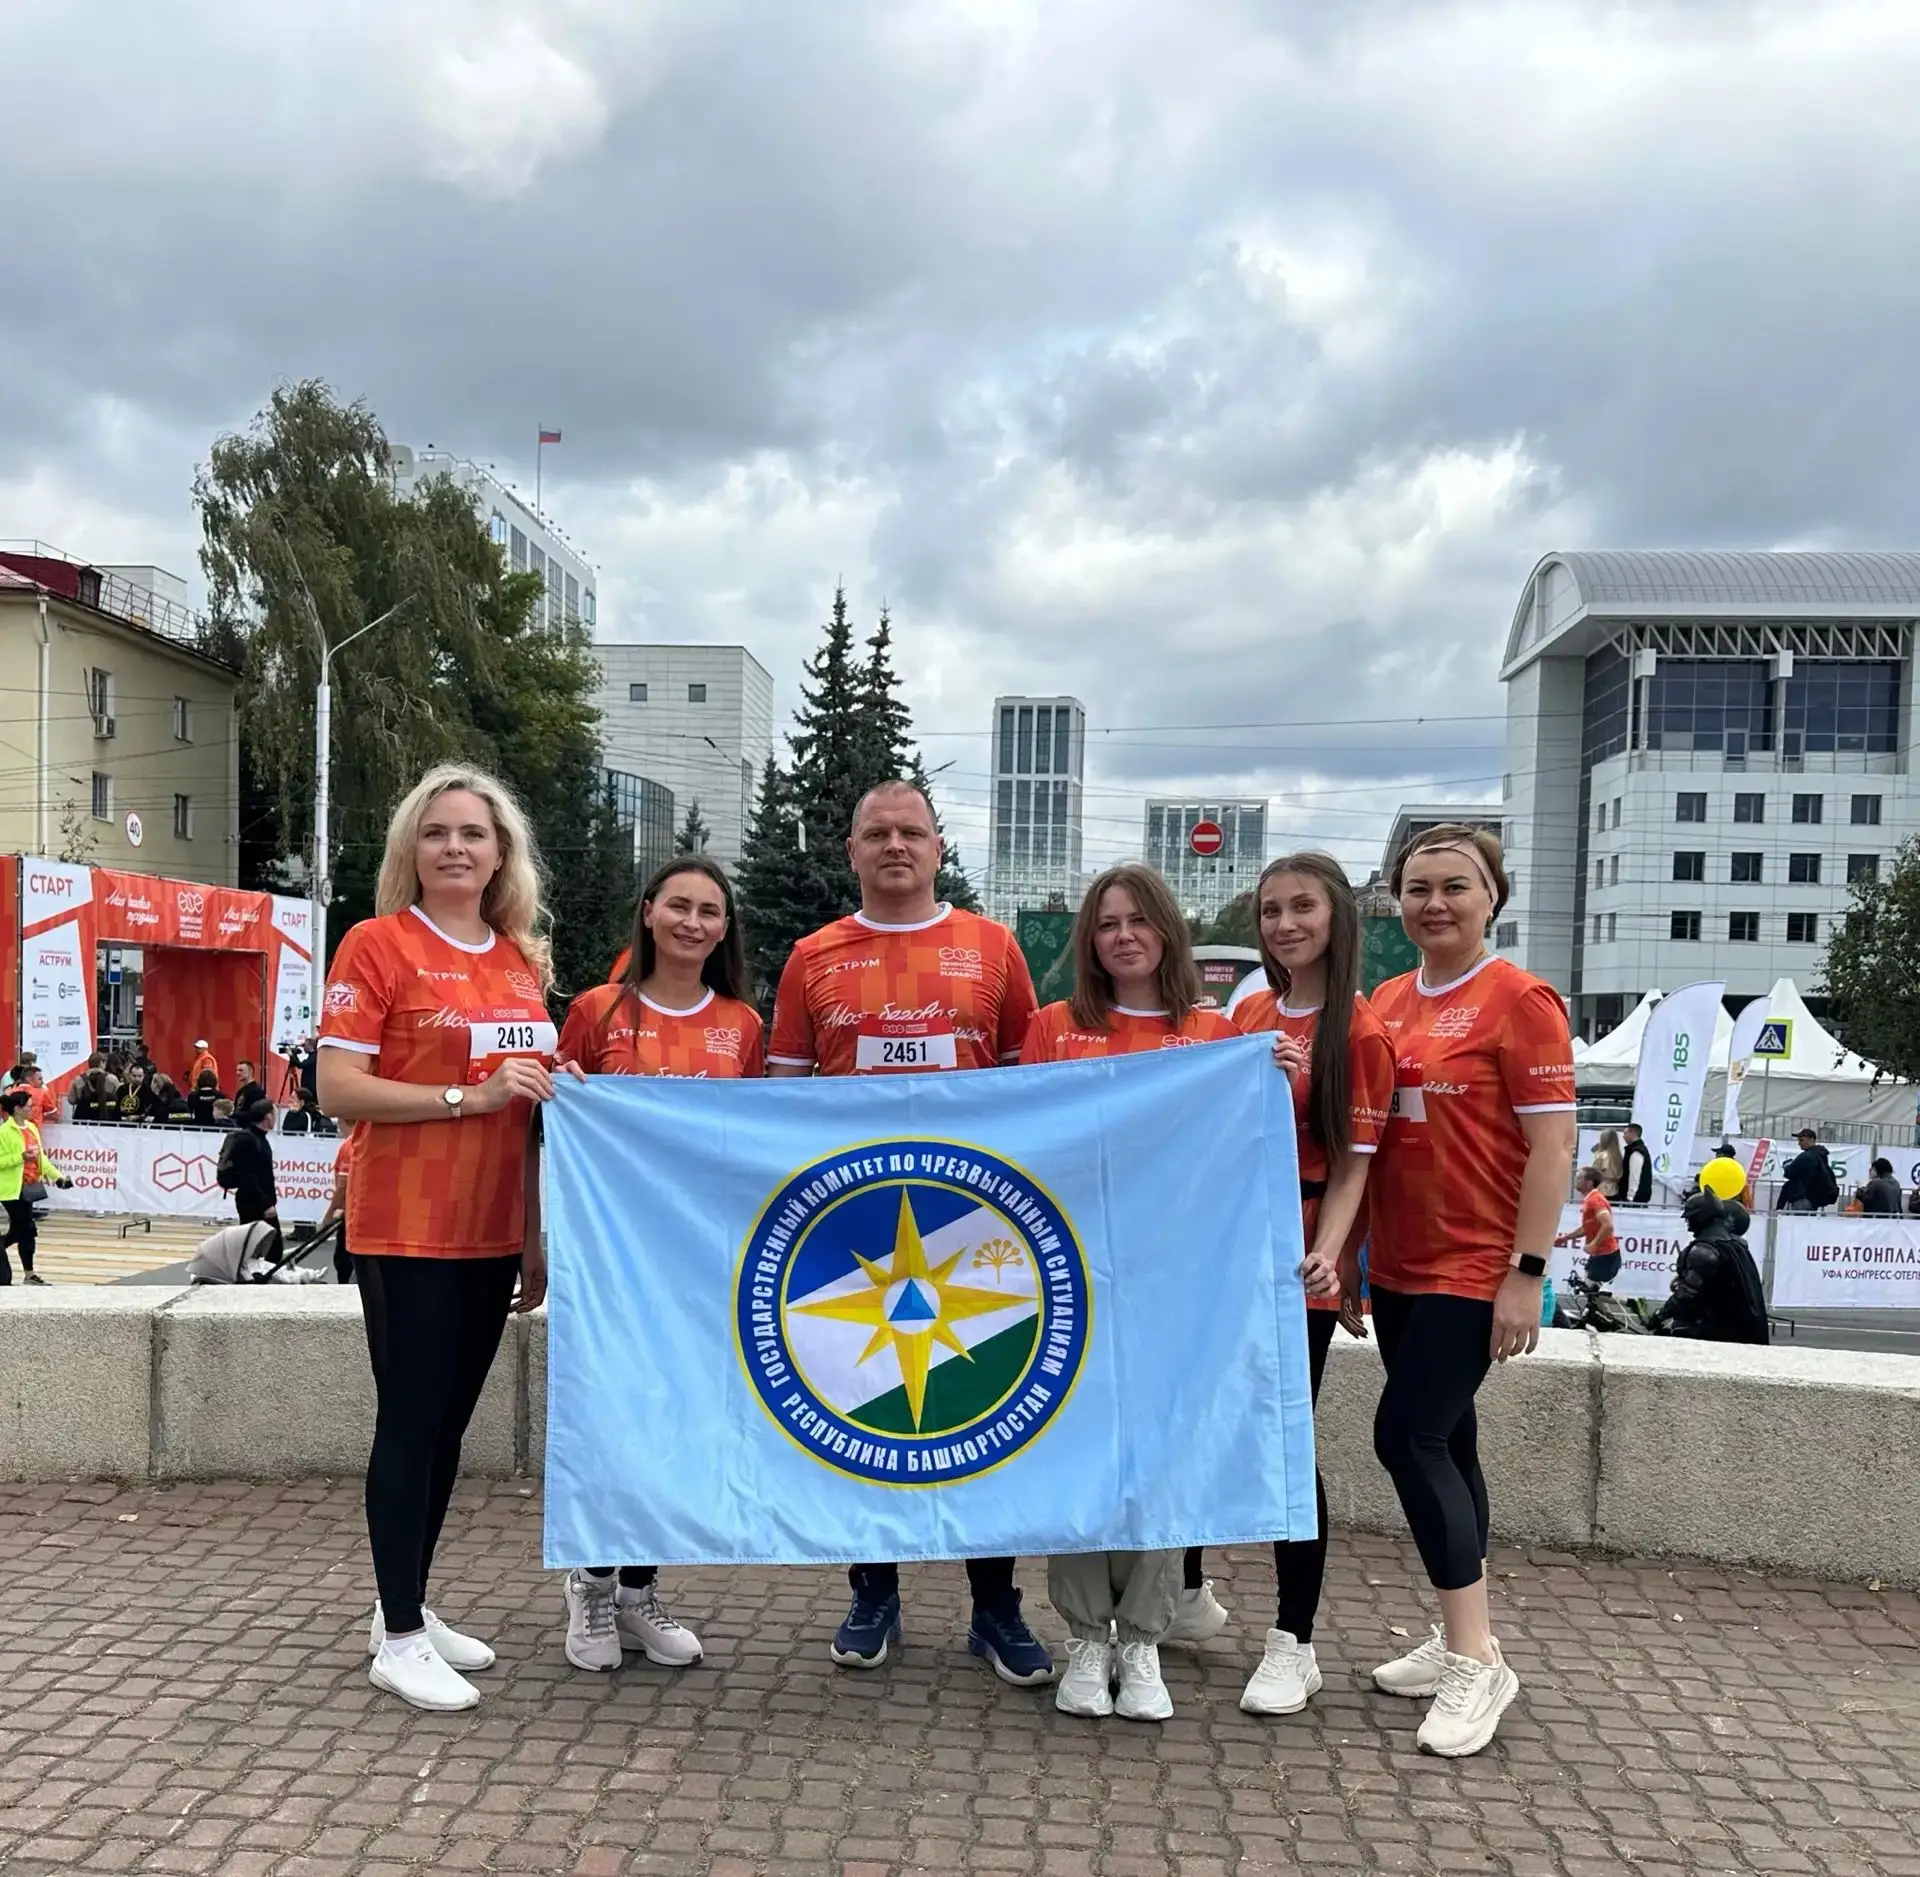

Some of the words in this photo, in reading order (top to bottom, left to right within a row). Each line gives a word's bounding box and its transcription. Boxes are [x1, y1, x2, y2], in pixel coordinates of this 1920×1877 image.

[130, 821, 140, 838] 40
[30, 874, 73, 897] СТАРТ
[282, 911, 307, 928] СТАРТ
[39, 954, 72, 967] АСТРУМ
[1203, 973, 1234, 982] ВМЕСТЕ
[498, 1026, 534, 1049] 2413
[1056, 1032, 1107, 1044] АСТРУМ
[883, 1041, 927, 1063] 2451
[1672, 1032, 1690, 1072] 185
[1664, 1092, 1683, 1146] СБЕР
[43, 1148, 118, 1164] ИМСКИЙ
[274, 1186, 335, 1200] АРАФО
[1806, 1245, 1920, 1263] ШЕРАТОНПЛА
[752, 1198, 809, 1388] ГОСУДАРСТВЕННЫЙ
[800, 1157, 884, 1208] КОМИТЕТ
[889, 1154, 915, 1172] ПО
[920, 1154, 1060, 1254] ЧРЕЗВЫЧАЙНЫМ
[1040, 1254, 1074, 1377] СИТУАЦИЯМ
[1822, 1269, 1841, 1279] УФА
[781, 1392, 898, 1472] РЕСПУБЛИКА
[907, 1382, 1052, 1472] БАШКОРТОСТАН
